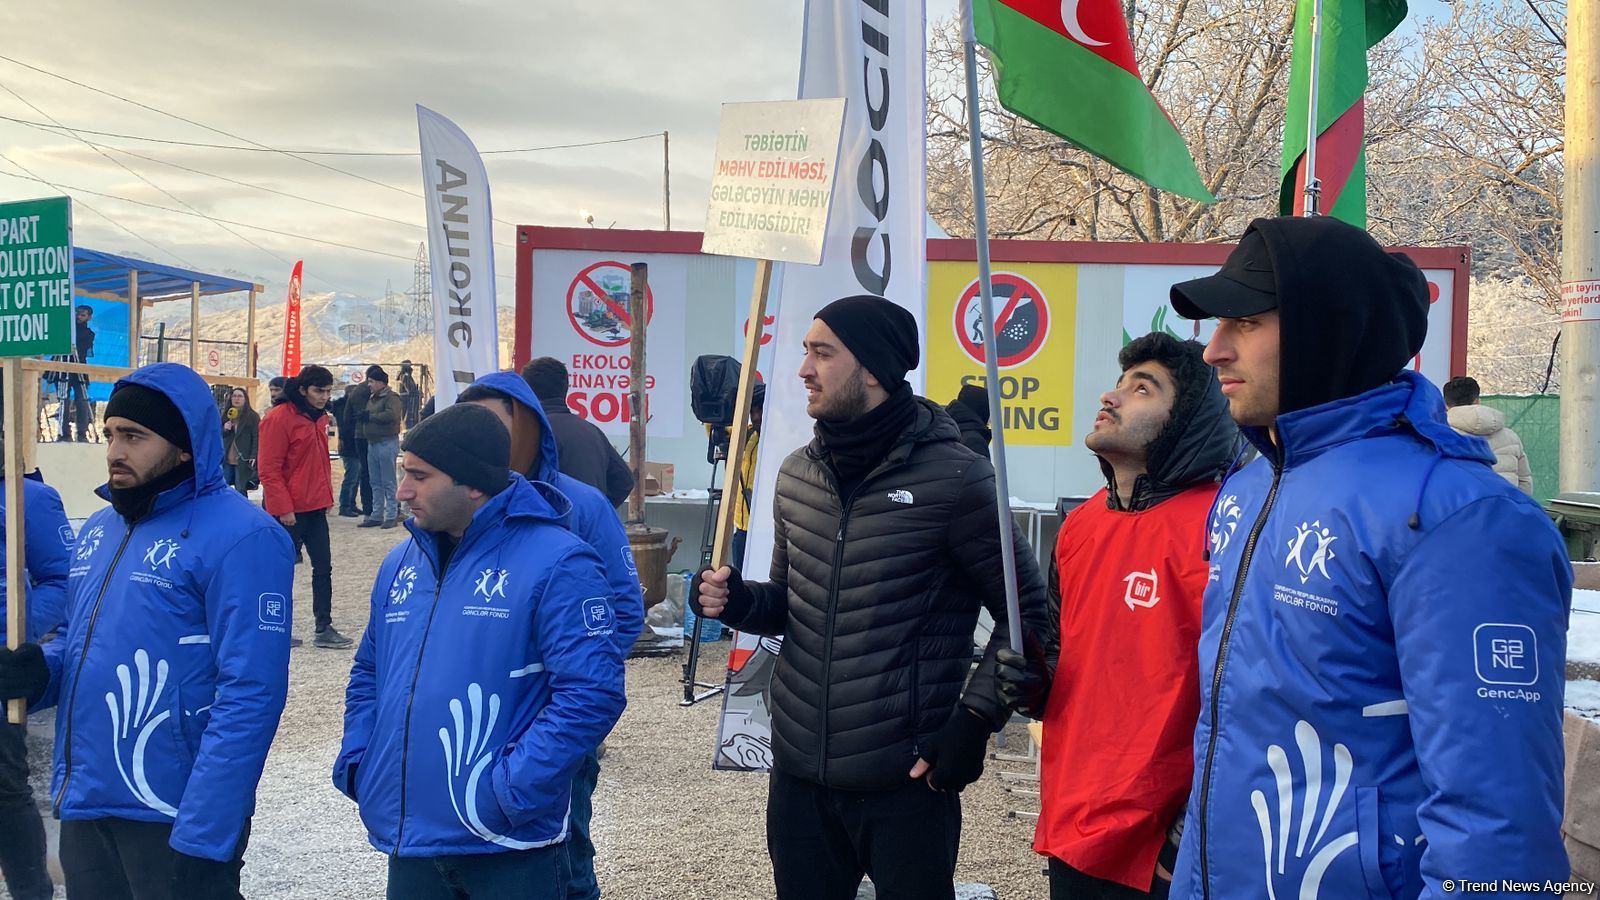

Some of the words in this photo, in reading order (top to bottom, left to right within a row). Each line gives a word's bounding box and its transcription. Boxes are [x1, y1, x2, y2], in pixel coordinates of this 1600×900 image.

[744, 130, 808, 152] TƏBİƏTİN
[851, 0, 891, 297] COCI
[718, 160, 755, 177] MƏHV
[758, 157, 828, 184] EDİLMƏSİ,
[711, 183, 785, 205] GƏLƏCƏYİN
[788, 188, 830, 208] MƏHV
[0, 215, 40, 246] PART
[719, 208, 811, 235] EDİLMƏSİDİR!
[0, 246, 68, 278] OLUTION
[14, 281, 35, 310] OF
[38, 279, 70, 308] THE
[572, 354, 632, 370] EKOLO
[568, 372, 656, 389] İNAYƏƏ
[1003, 406, 1060, 431] ING
[1134, 580, 1151, 598] bir
[1305, 600, 1338, 616] FONDU
[1476, 687, 1541, 702] GencApp
